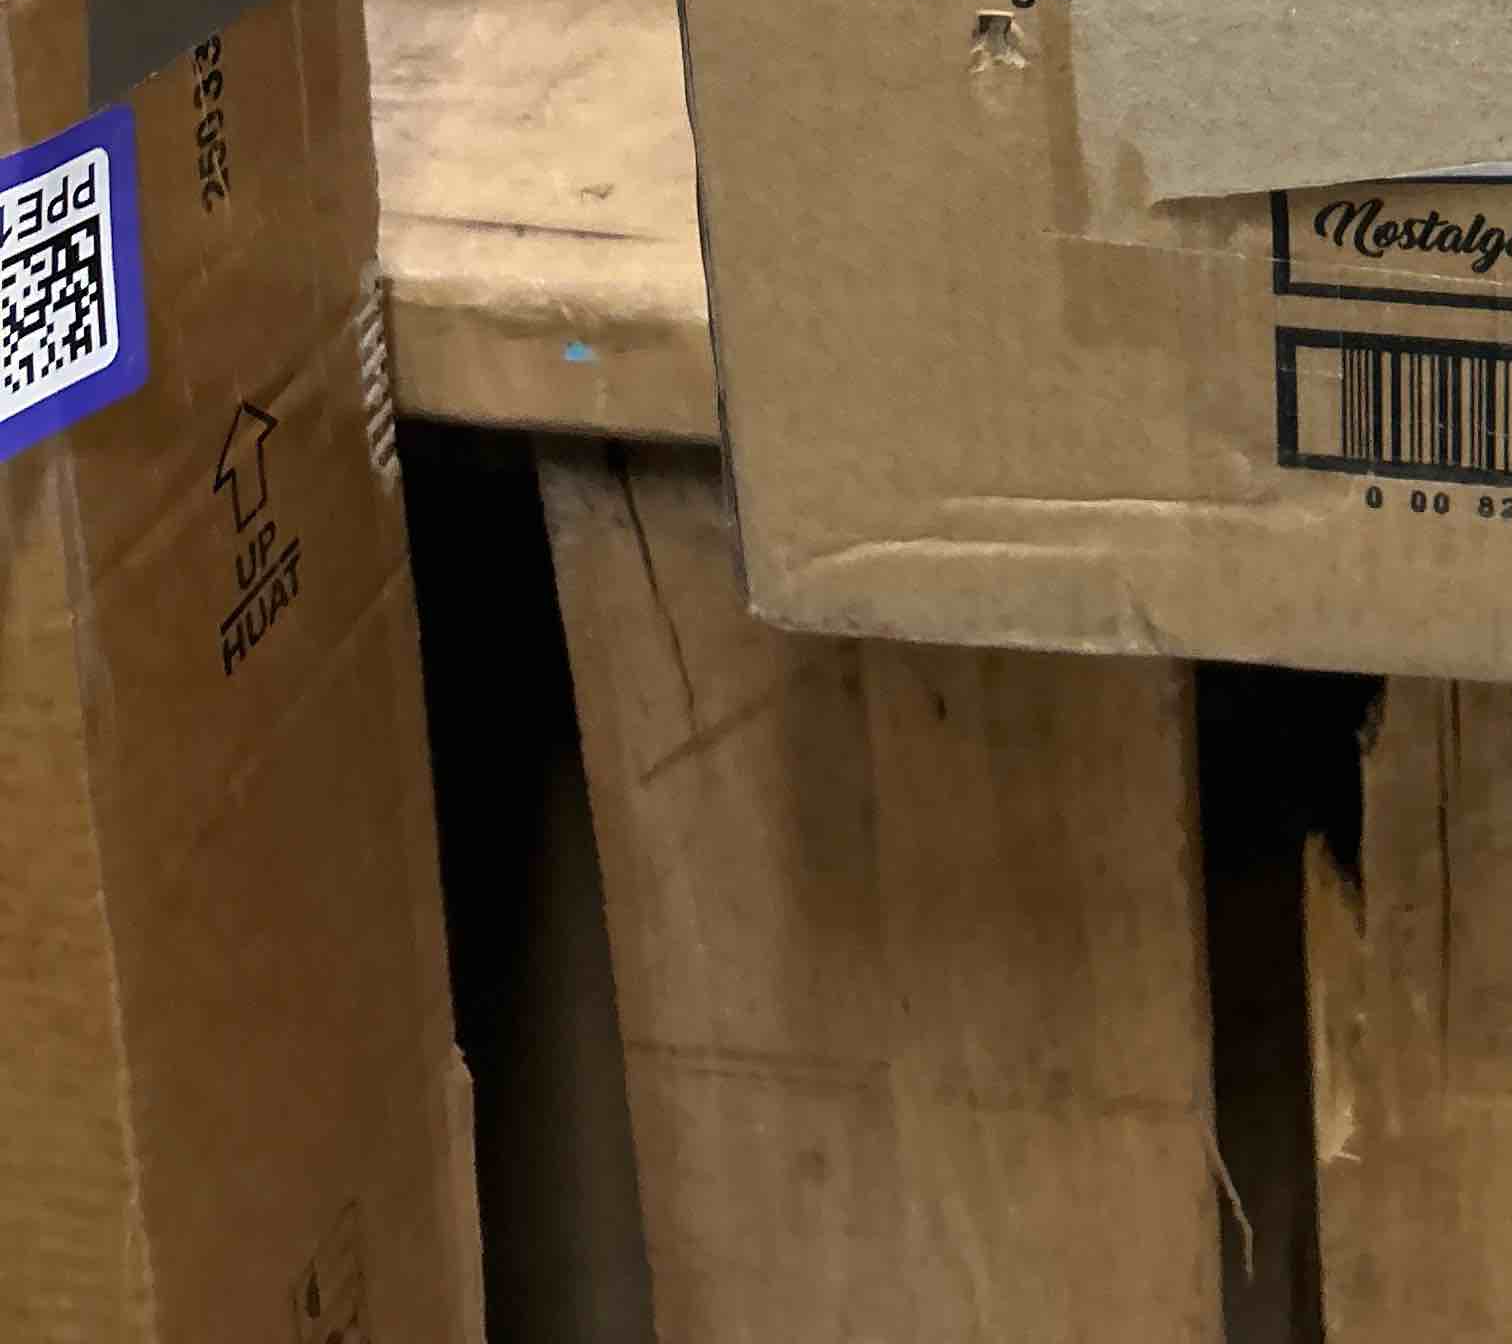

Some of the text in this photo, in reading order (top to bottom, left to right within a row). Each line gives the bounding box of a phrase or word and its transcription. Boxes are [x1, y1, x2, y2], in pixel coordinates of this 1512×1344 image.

[1364, 484, 1384, 510] 0
[1409, 489, 1451, 515] 00
[235, 520, 277, 591] UP
